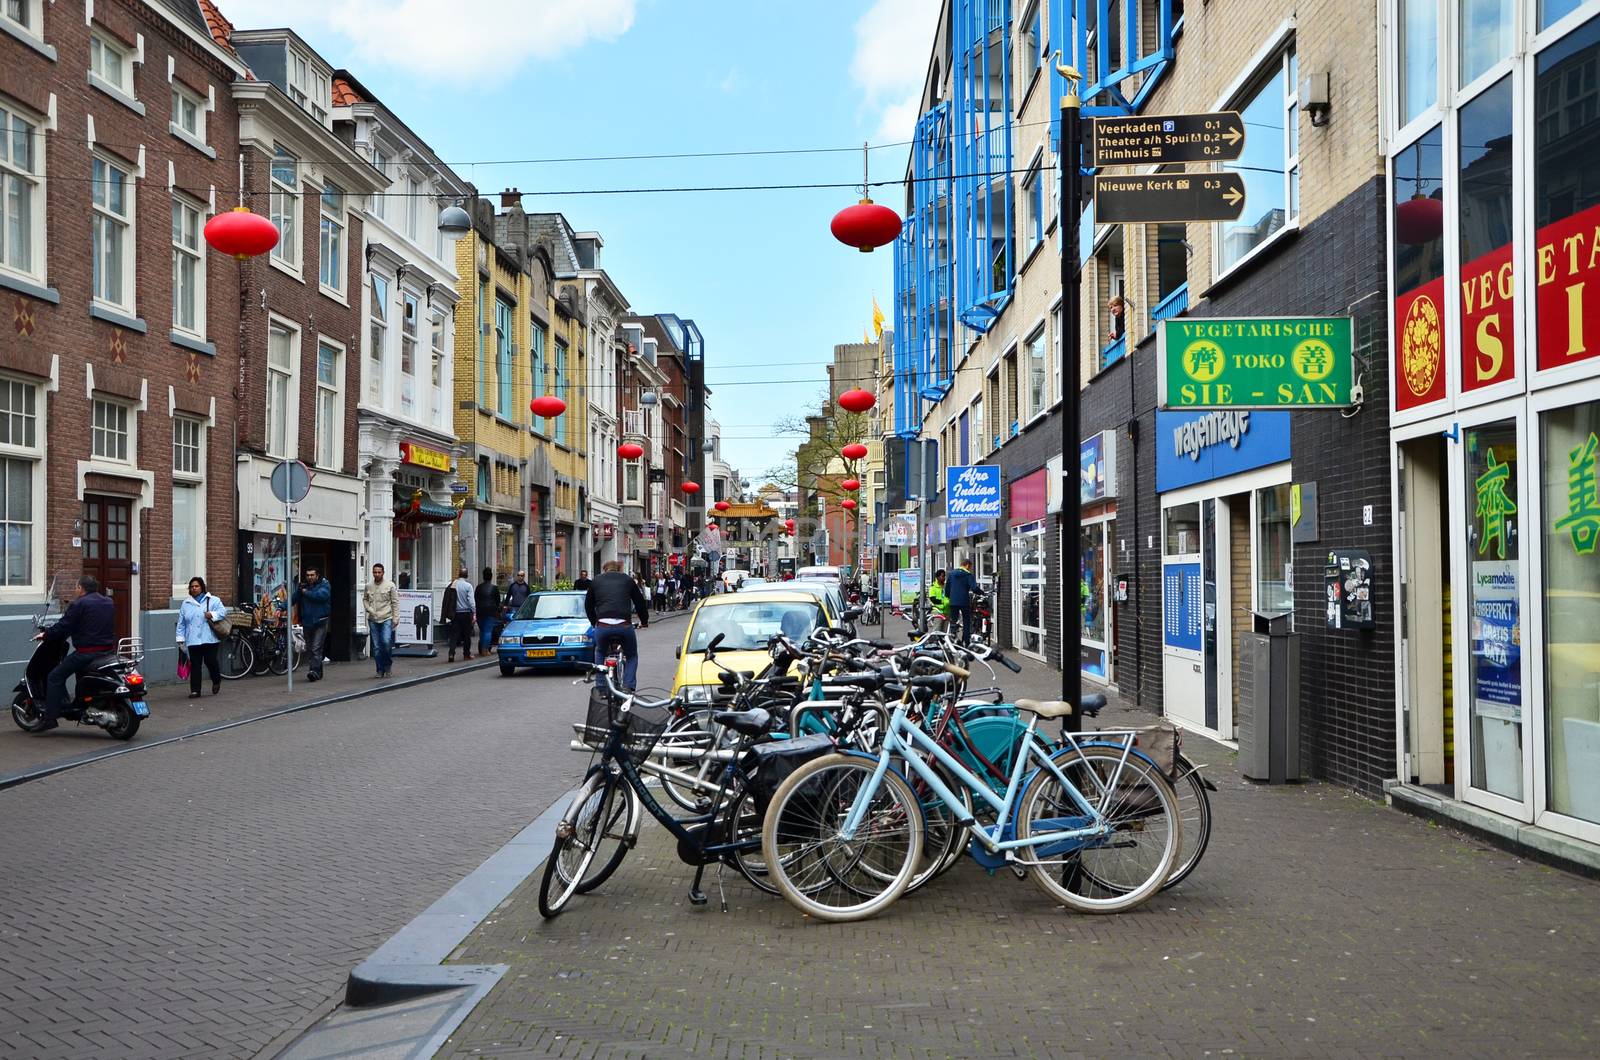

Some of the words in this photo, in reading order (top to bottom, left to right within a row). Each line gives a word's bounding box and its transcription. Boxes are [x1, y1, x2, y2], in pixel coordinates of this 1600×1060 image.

[1098, 122, 1161, 135] Veerkaden
[1098, 137, 1141, 147] Theater
[1144, 135, 1162, 145] a/h
[1165, 133, 1189, 145] Spui
[1098, 147, 1150, 159] Filmhuis
[1099, 181, 1143, 192] Nieuwe
[1147, 180, 1174, 190] Kerk
[1182, 322, 1335, 337] VEGETARISCHE
[1232, 353, 1286, 369] TOKO
[1180, 383, 1233, 405] SIE
[1277, 383, 1338, 405] SAN
[958, 467, 989, 486] Afro
[952, 483, 997, 498] Indian
[949, 497, 999, 512] Market
